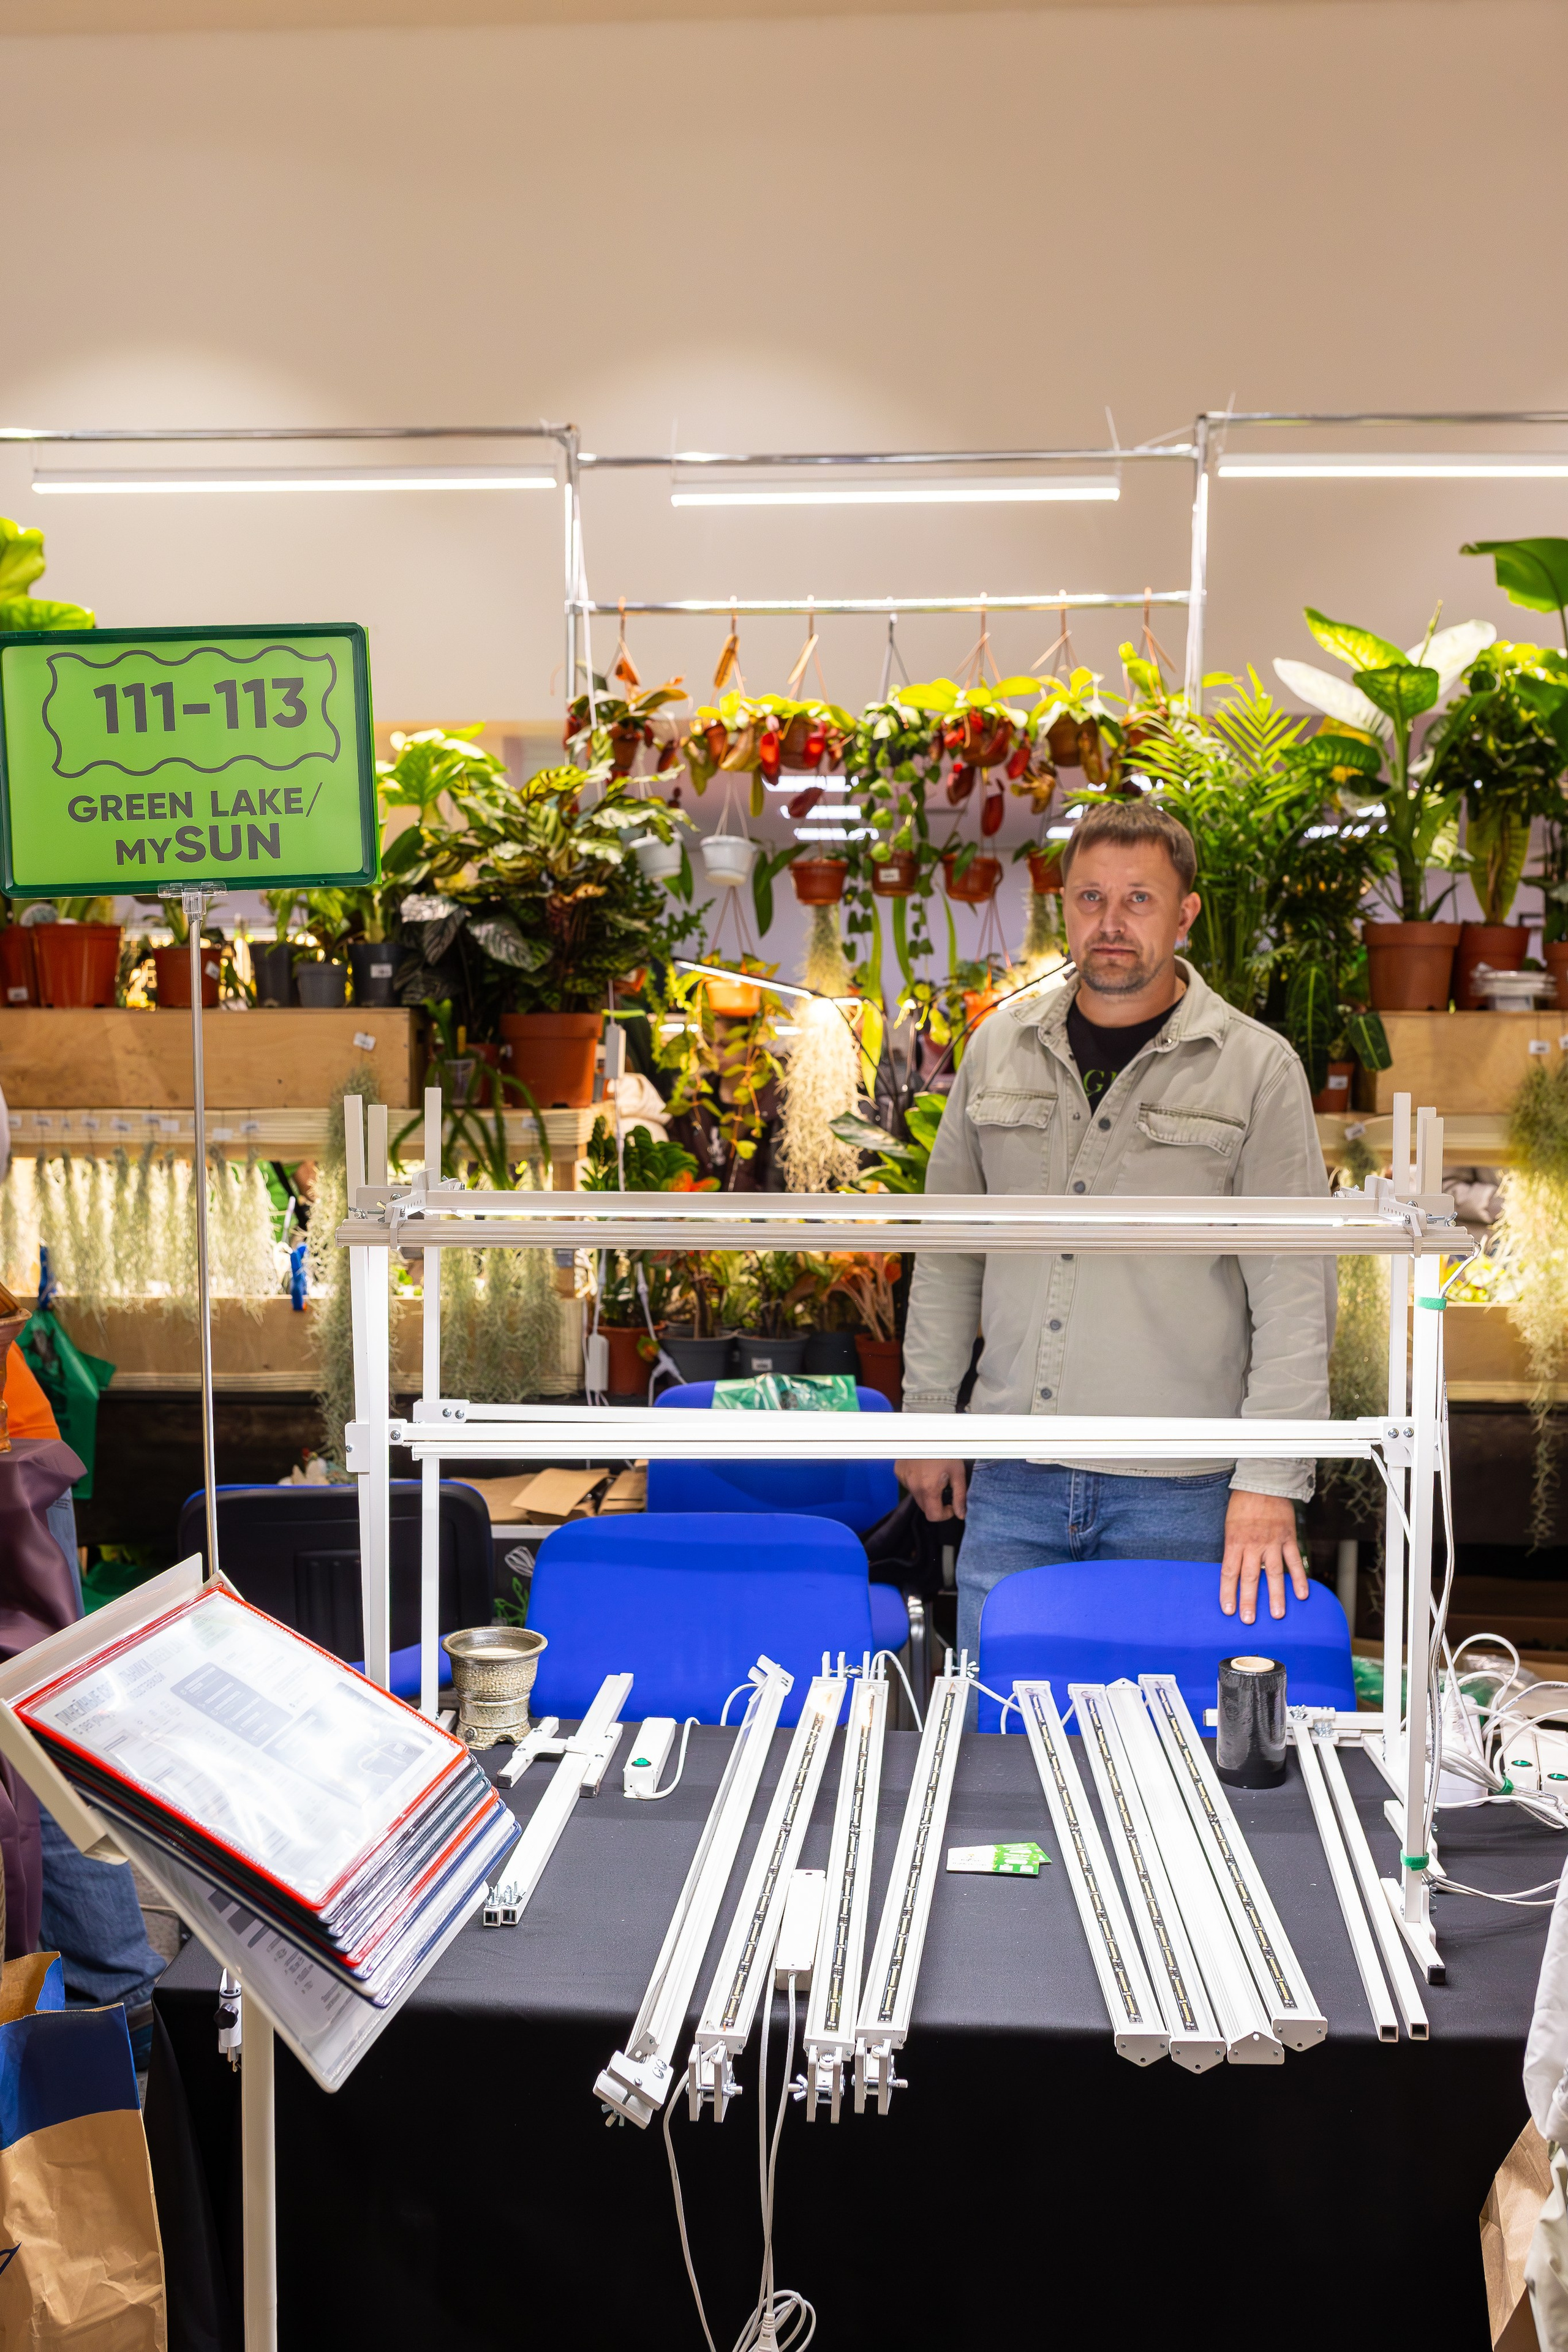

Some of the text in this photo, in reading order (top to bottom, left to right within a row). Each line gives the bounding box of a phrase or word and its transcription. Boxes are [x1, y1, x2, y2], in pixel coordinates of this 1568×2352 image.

[93, 677, 307, 733] 111-113
[67, 782, 323, 823] GREEN LAKE/
